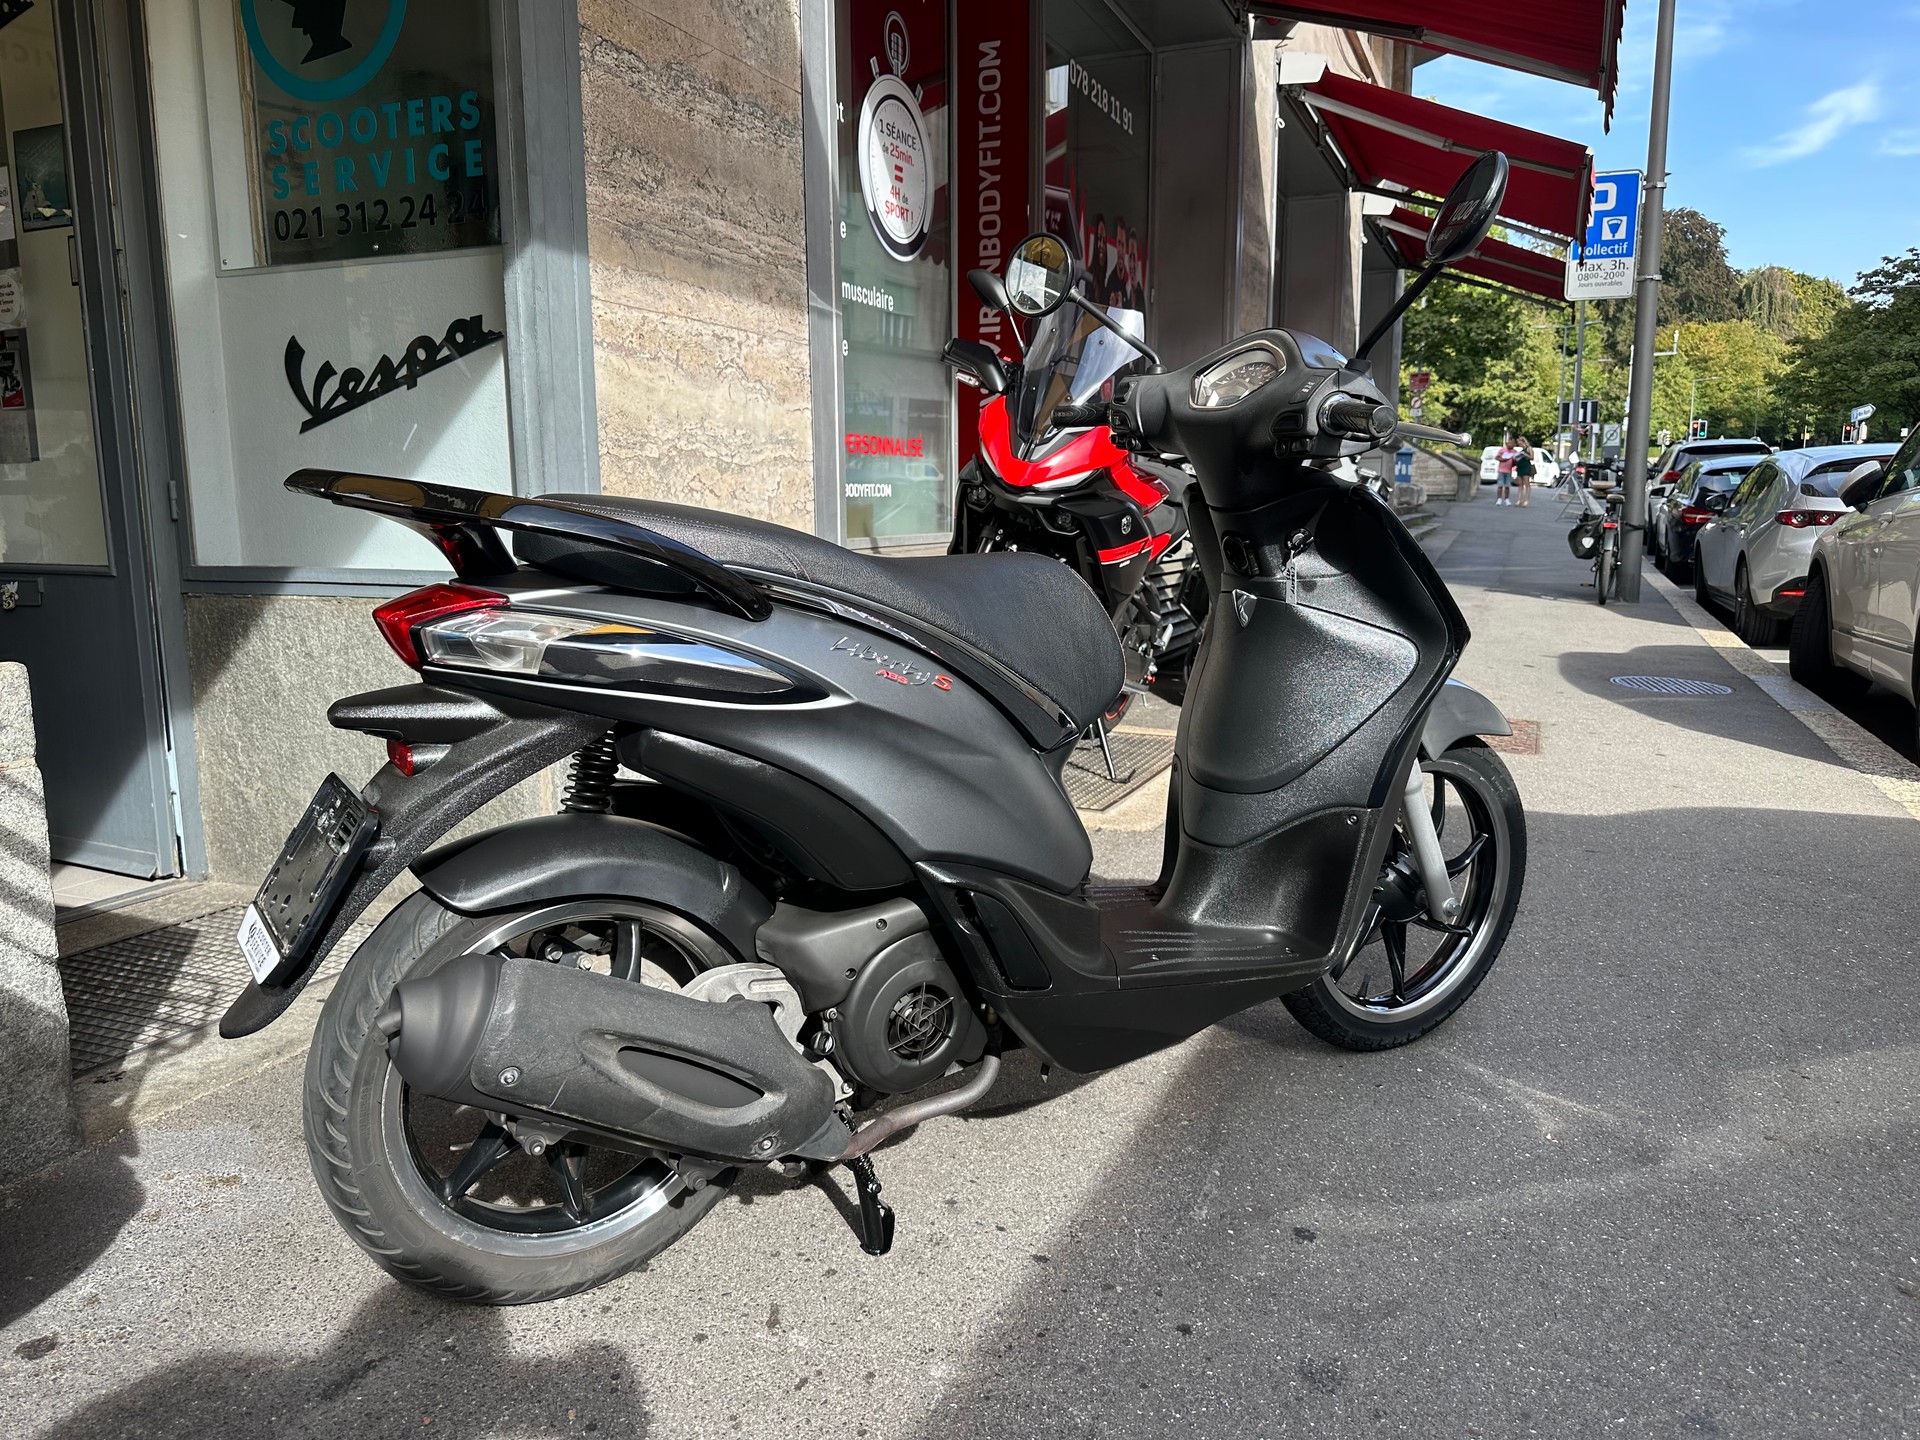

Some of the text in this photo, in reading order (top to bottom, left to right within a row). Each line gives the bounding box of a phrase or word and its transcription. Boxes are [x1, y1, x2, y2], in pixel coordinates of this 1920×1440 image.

[1069, 58, 1133, 135] 078 218 11 91
[268, 90, 481, 155] SCOOTERS
[879, 119, 917, 150] 1 SÉANCE
[272, 139, 484, 200] SERVICE
[882, 142, 914, 167] de 25min.
[889, 185, 908, 204] 4H de
[274, 188, 487, 242] 021 312 24 24
[885, 200, 909, 221] SPORT
[1576, 260, 1629, 272] Max. 3h.
[841, 281, 894, 311] musculaire
[284, 314, 504, 434] Vespa
[830, 636, 953, 691] Liberty S
[876, 669, 908, 685] ABS
